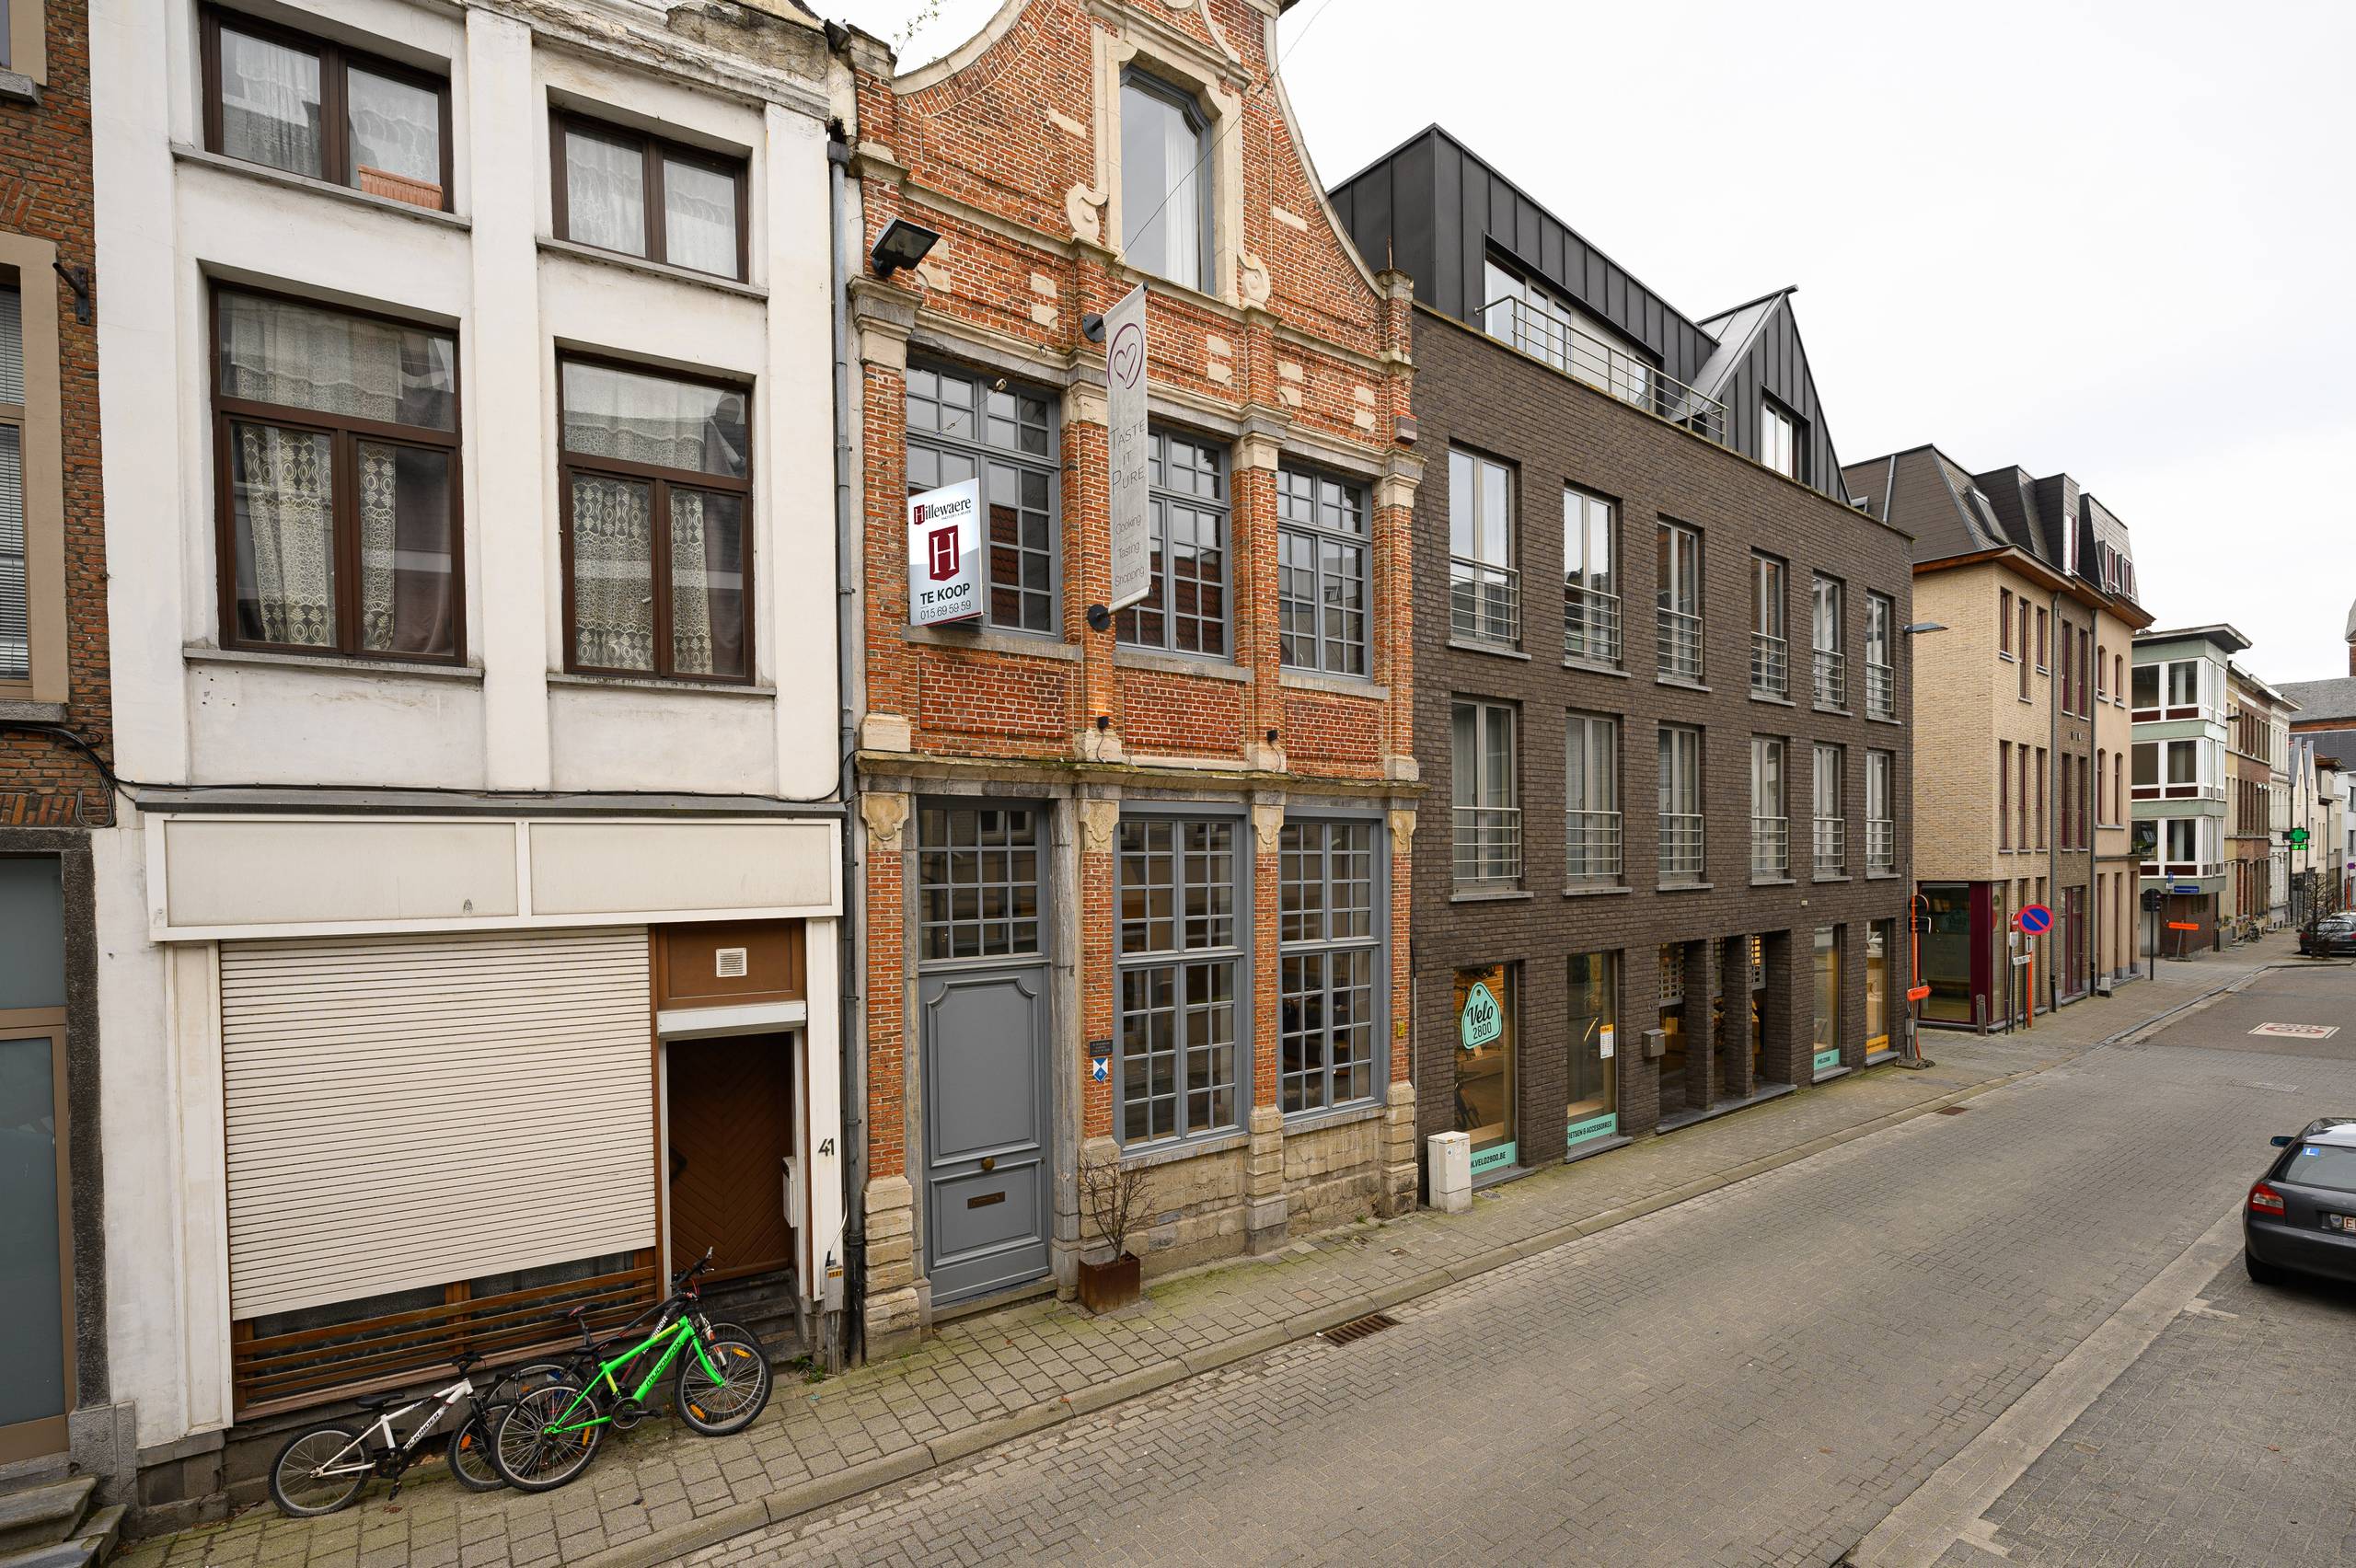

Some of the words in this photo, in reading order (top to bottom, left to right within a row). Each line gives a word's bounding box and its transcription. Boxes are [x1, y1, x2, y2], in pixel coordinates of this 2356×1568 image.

[1110, 419, 1146, 449] TASTE
[1112, 466, 1145, 495] PURE
[914, 498, 972, 524] Hillewaere
[1115, 514, 1141, 535] Cooking
[931, 531, 957, 575] H
[1119, 542, 1140, 559] Tasting
[1114, 566, 1145, 587] Shopping
[919, 591, 935, 605] TE
[937, 582, 971, 602] KOOP
[920, 607, 936, 620] 015
[937, 605, 948, 617] 69
[949, 602, 959, 614] 59
[961, 599, 972, 611] 59
[1467, 1000, 1494, 1026] Velo
[1472, 1021, 1492, 1040] 2800
[1567, 1129, 1583, 1139] IETSEN
[818, 1137, 835, 1157] 41
[1470, 1151, 1507, 1170] W.VELO2800.BE
[404, 1412, 441, 1449] OCKRIDER
